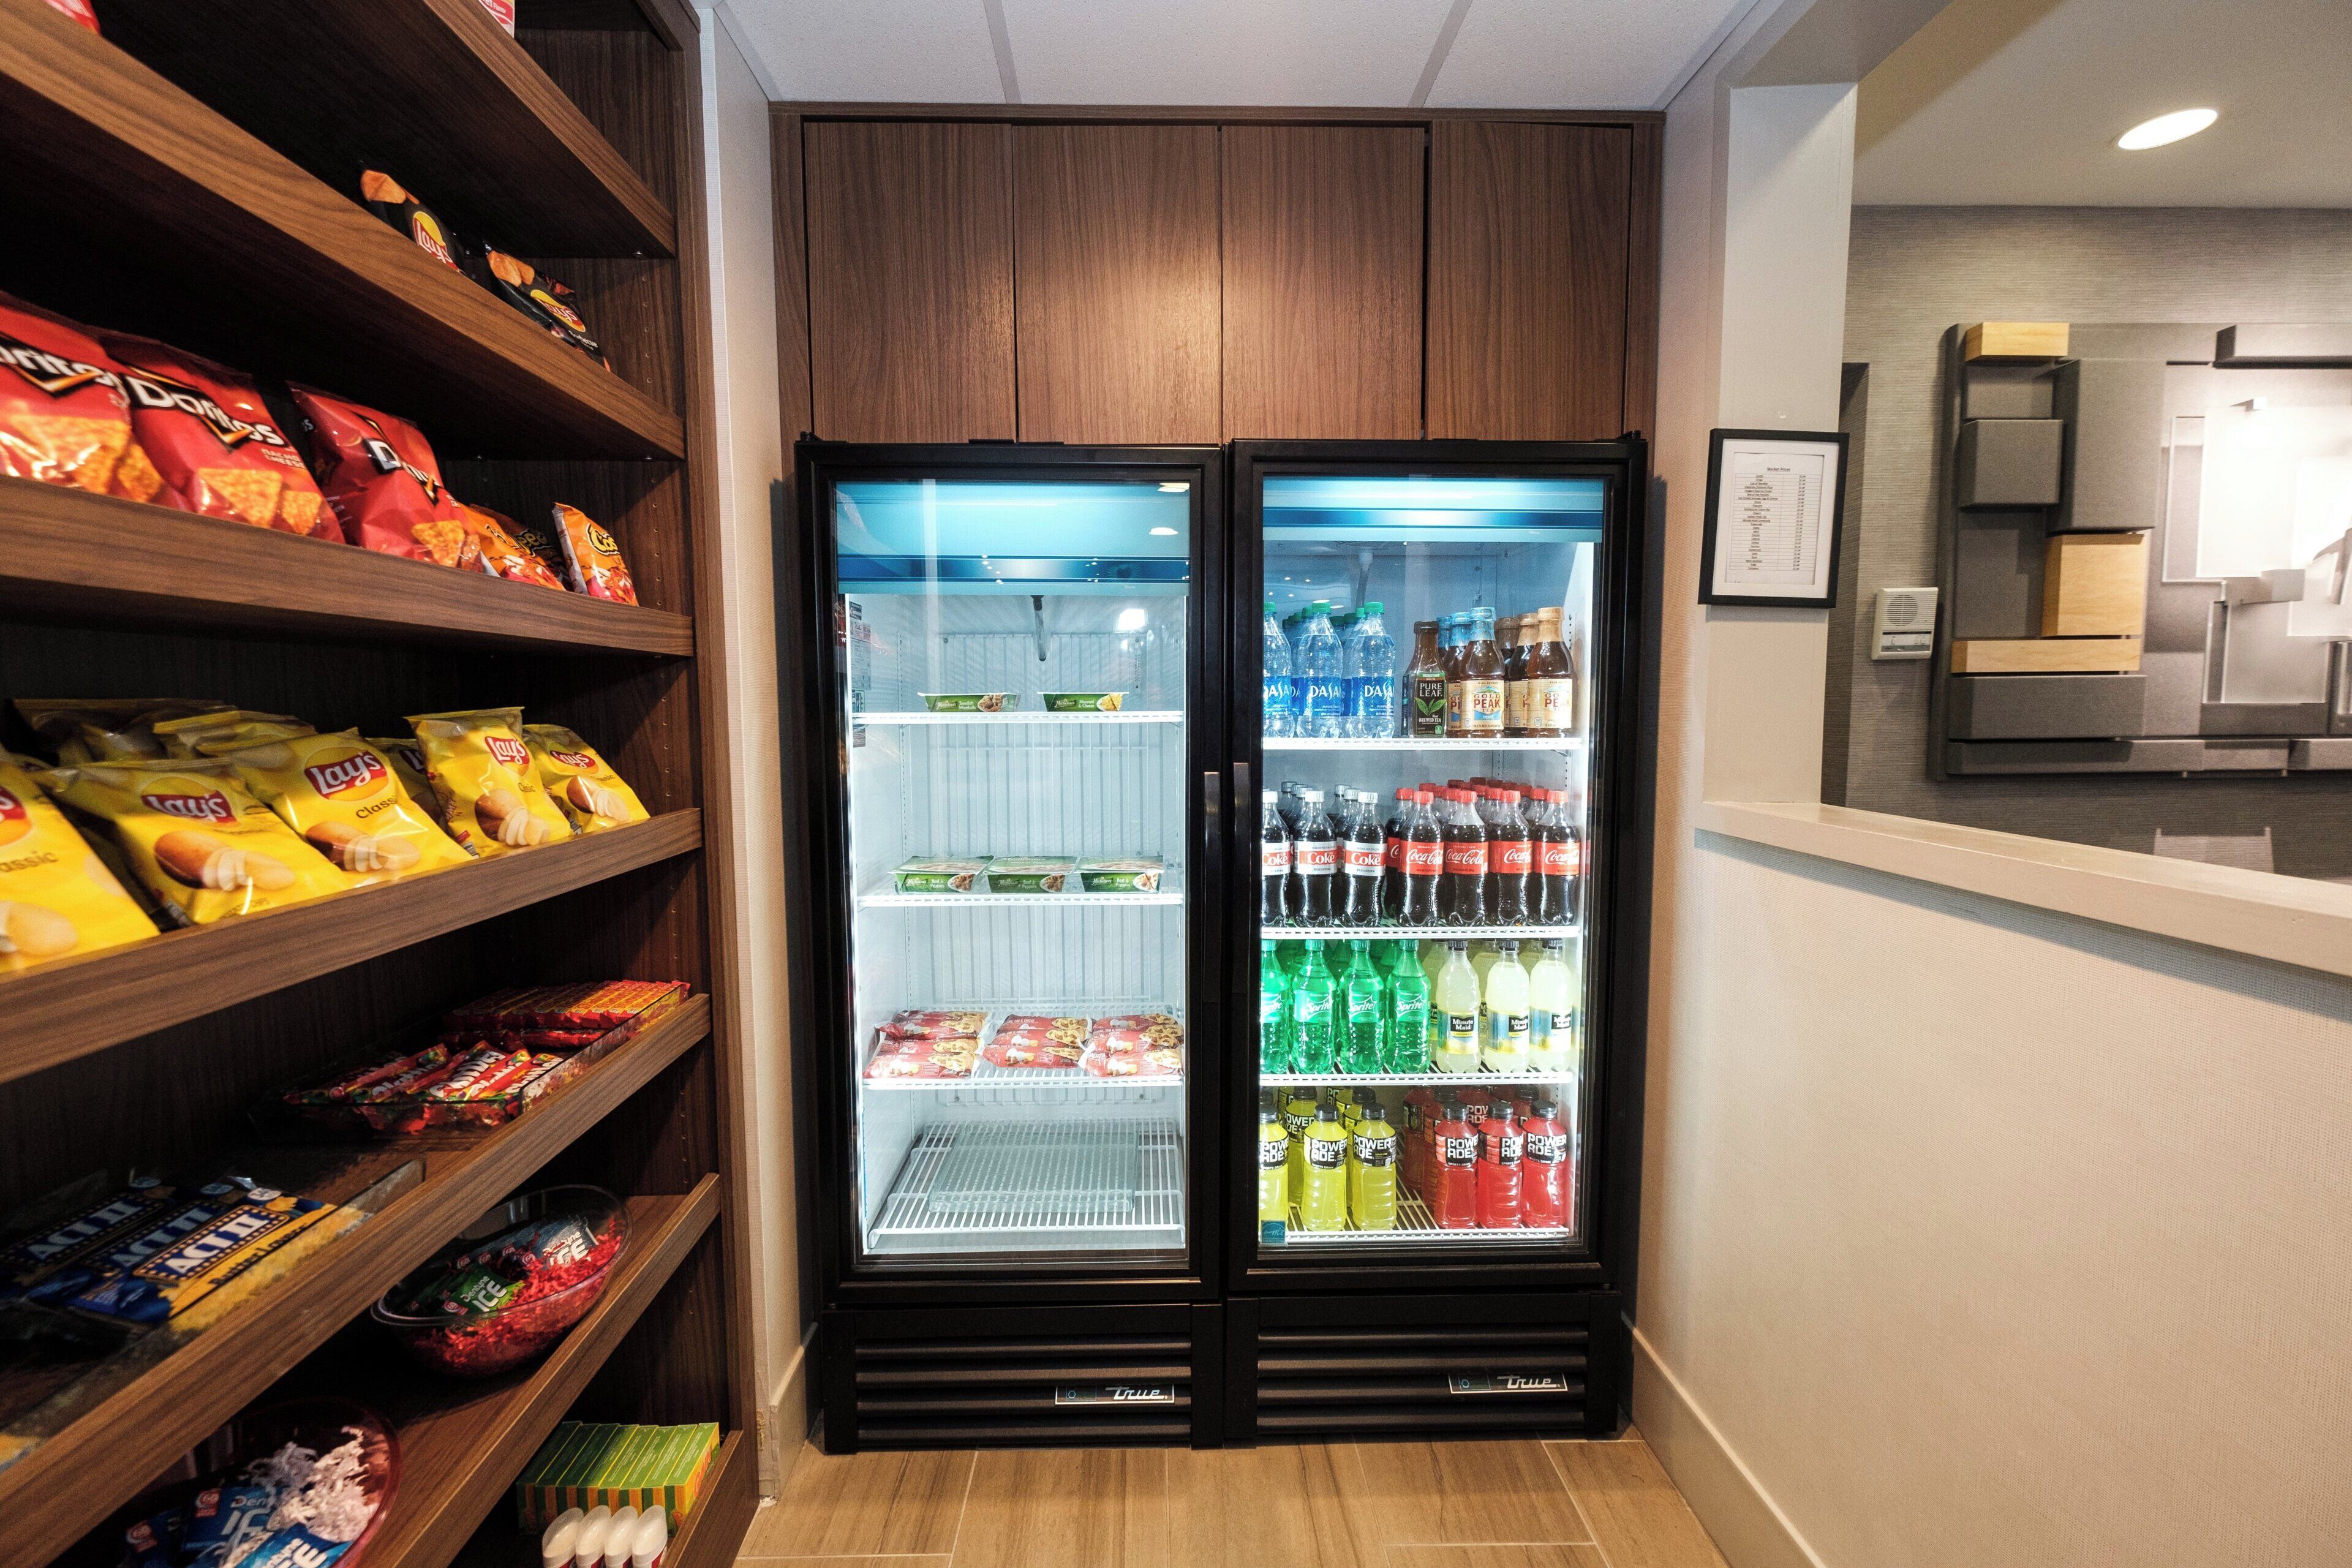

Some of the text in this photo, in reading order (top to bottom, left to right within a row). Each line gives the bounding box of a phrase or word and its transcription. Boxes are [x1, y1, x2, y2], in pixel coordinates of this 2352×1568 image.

[0, 344, 116, 388] oritos
[126, 374, 285, 445] Doritos
[1311, 682, 1341, 700] DASA
[1473, 699, 1501, 709] PEAK
[487, 736, 526, 765] Lay's
[552, 751, 590, 769] Lay's
[310, 753, 382, 794] Lay's
[146, 794, 227, 823] Lay's
[1262, 852, 1288, 865] Coke
[1307, 852, 1335, 864] Coke
[1351, 852, 1381, 865] Coke
[1398, 1001, 1423, 1012] Sprite
[1467, 1104, 1488, 1115] POW
[1262, 1139, 1289, 1153] POWE
[1311, 1139, 1348, 1152] POWER
[1354, 1134, 1391, 1150] POWER
[1447, 1134, 1478, 1148] POWE
[1502, 1134, 1523, 1148] POW
[1528, 1133, 1567, 1147] POWER
[1311, 1150, 1335, 1162] ADE
[1354, 1144, 1373, 1159] ADE
[1447, 1148, 1471, 1159] ADE
[1528, 1143, 1552, 1156] ADE
[163, 1213, 270, 1275] ACT II
[460, 1275, 490, 1303] Dentyne
[472, 1279, 508, 1312] ICE
